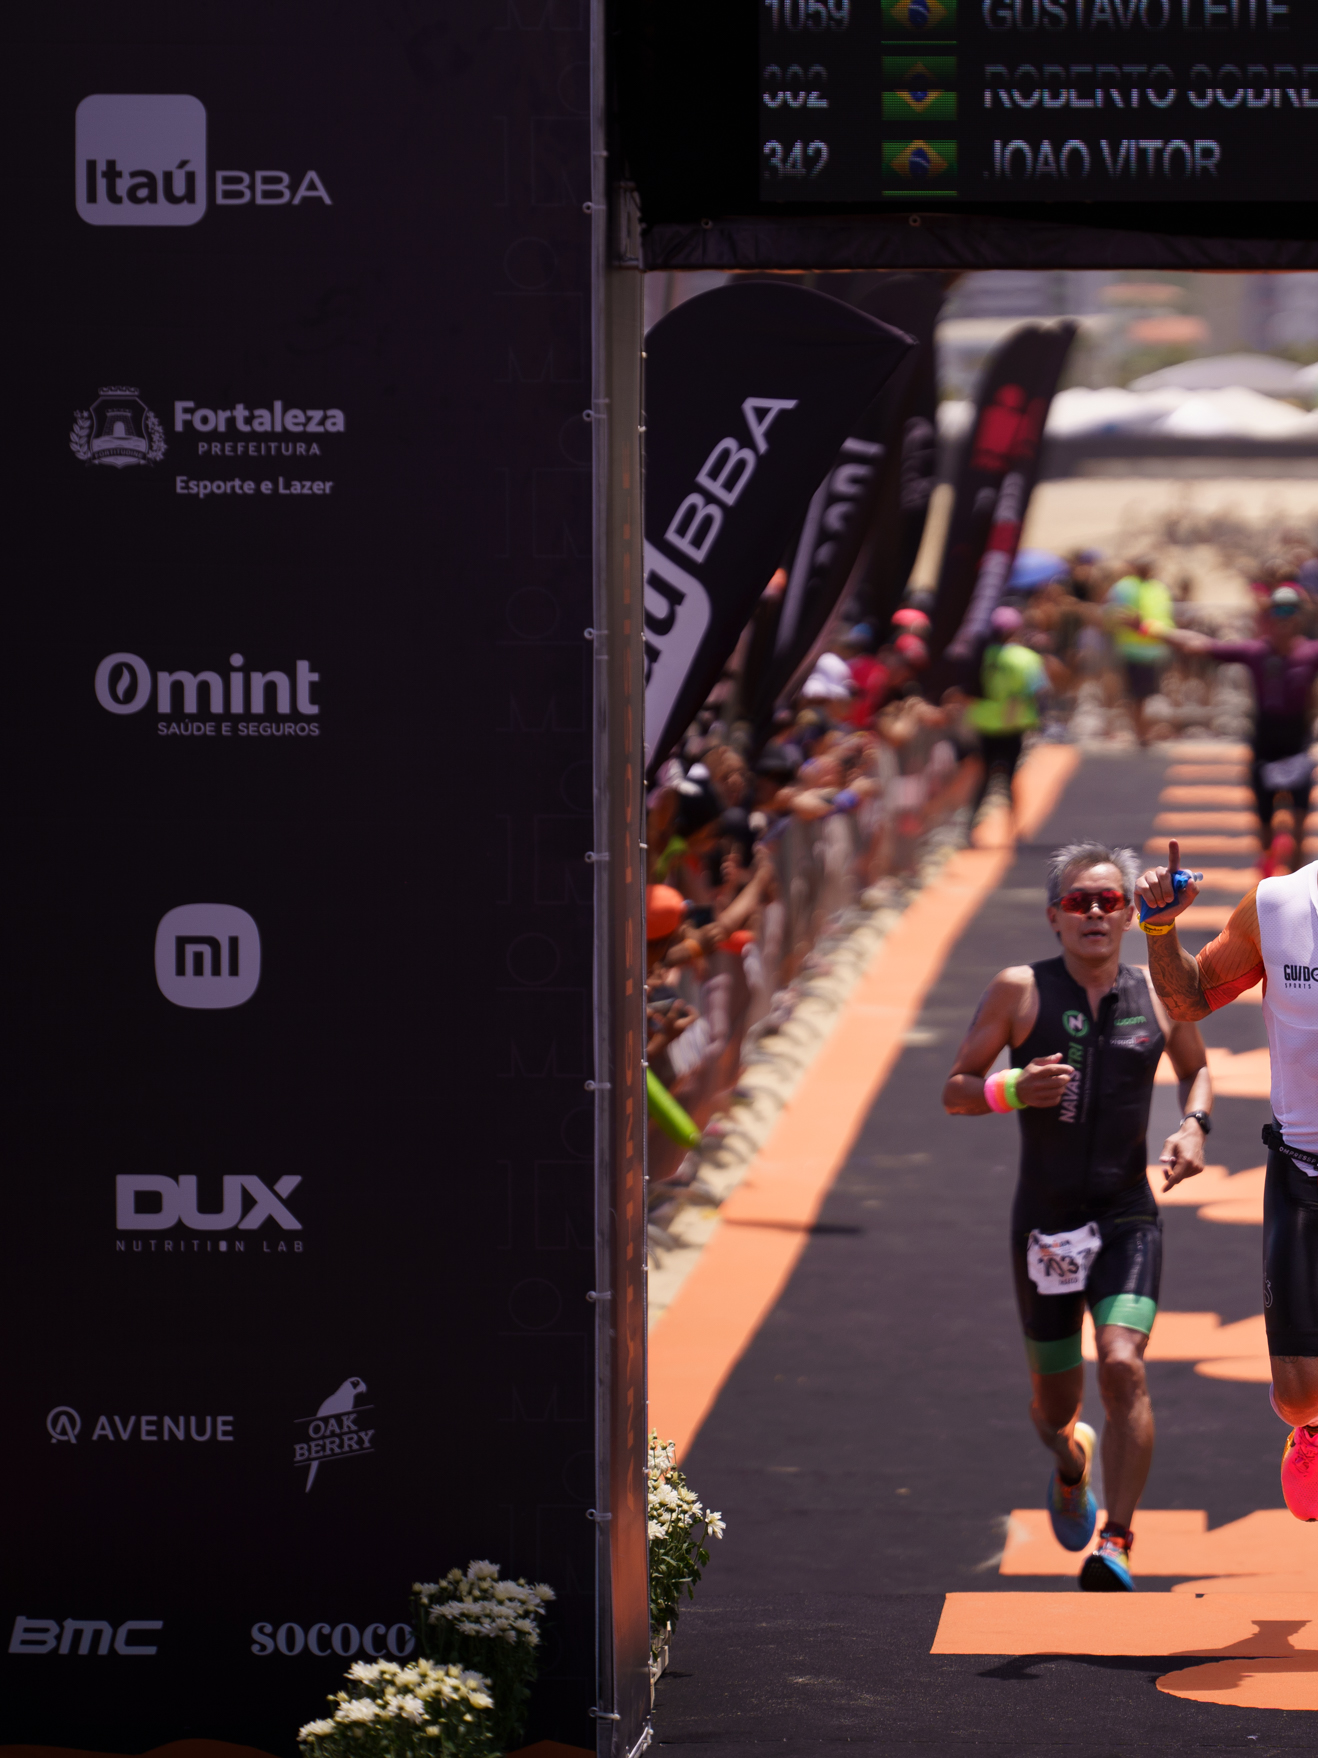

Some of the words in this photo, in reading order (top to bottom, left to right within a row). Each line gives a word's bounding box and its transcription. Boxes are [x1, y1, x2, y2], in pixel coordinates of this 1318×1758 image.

[980, 0, 1171, 31] GUSTAVO
[1182, 0, 1291, 31] LEITE
[982, 64, 1177, 108] ROBERTO
[763, 139, 829, 178] 342
[981, 139, 1091, 179] JOAO
[1099, 139, 1223, 179] VITOR
[86, 159, 196, 205] Itaú
[215, 170, 333, 205] BBA
[174, 400, 345, 433] Fortaleza
[198, 441, 321, 456] PREFEITURA
[176, 475, 256, 499] Esporte
[260, 480, 273, 494] e
[278, 476, 334, 495] Lazer
[663, 396, 799, 564] BBA
[94, 652, 320, 715] Omint
[157, 718, 216, 736] SAÚDE
[221, 722, 232, 736] E
[238, 722, 320, 736] SEGUROS
[1284, 982, 1312, 990] SPORTS
[115, 1174, 303, 1231] DUX
[263, 1240, 304, 1253] LAB
[91, 1415, 234, 1442] AVENUE
[308, 1412, 358, 1437] OAK
[293, 1429, 375, 1462] BERRY
[8, 1615, 164, 1656] BMC
[251, 1621, 413, 1657] SOCOCO
